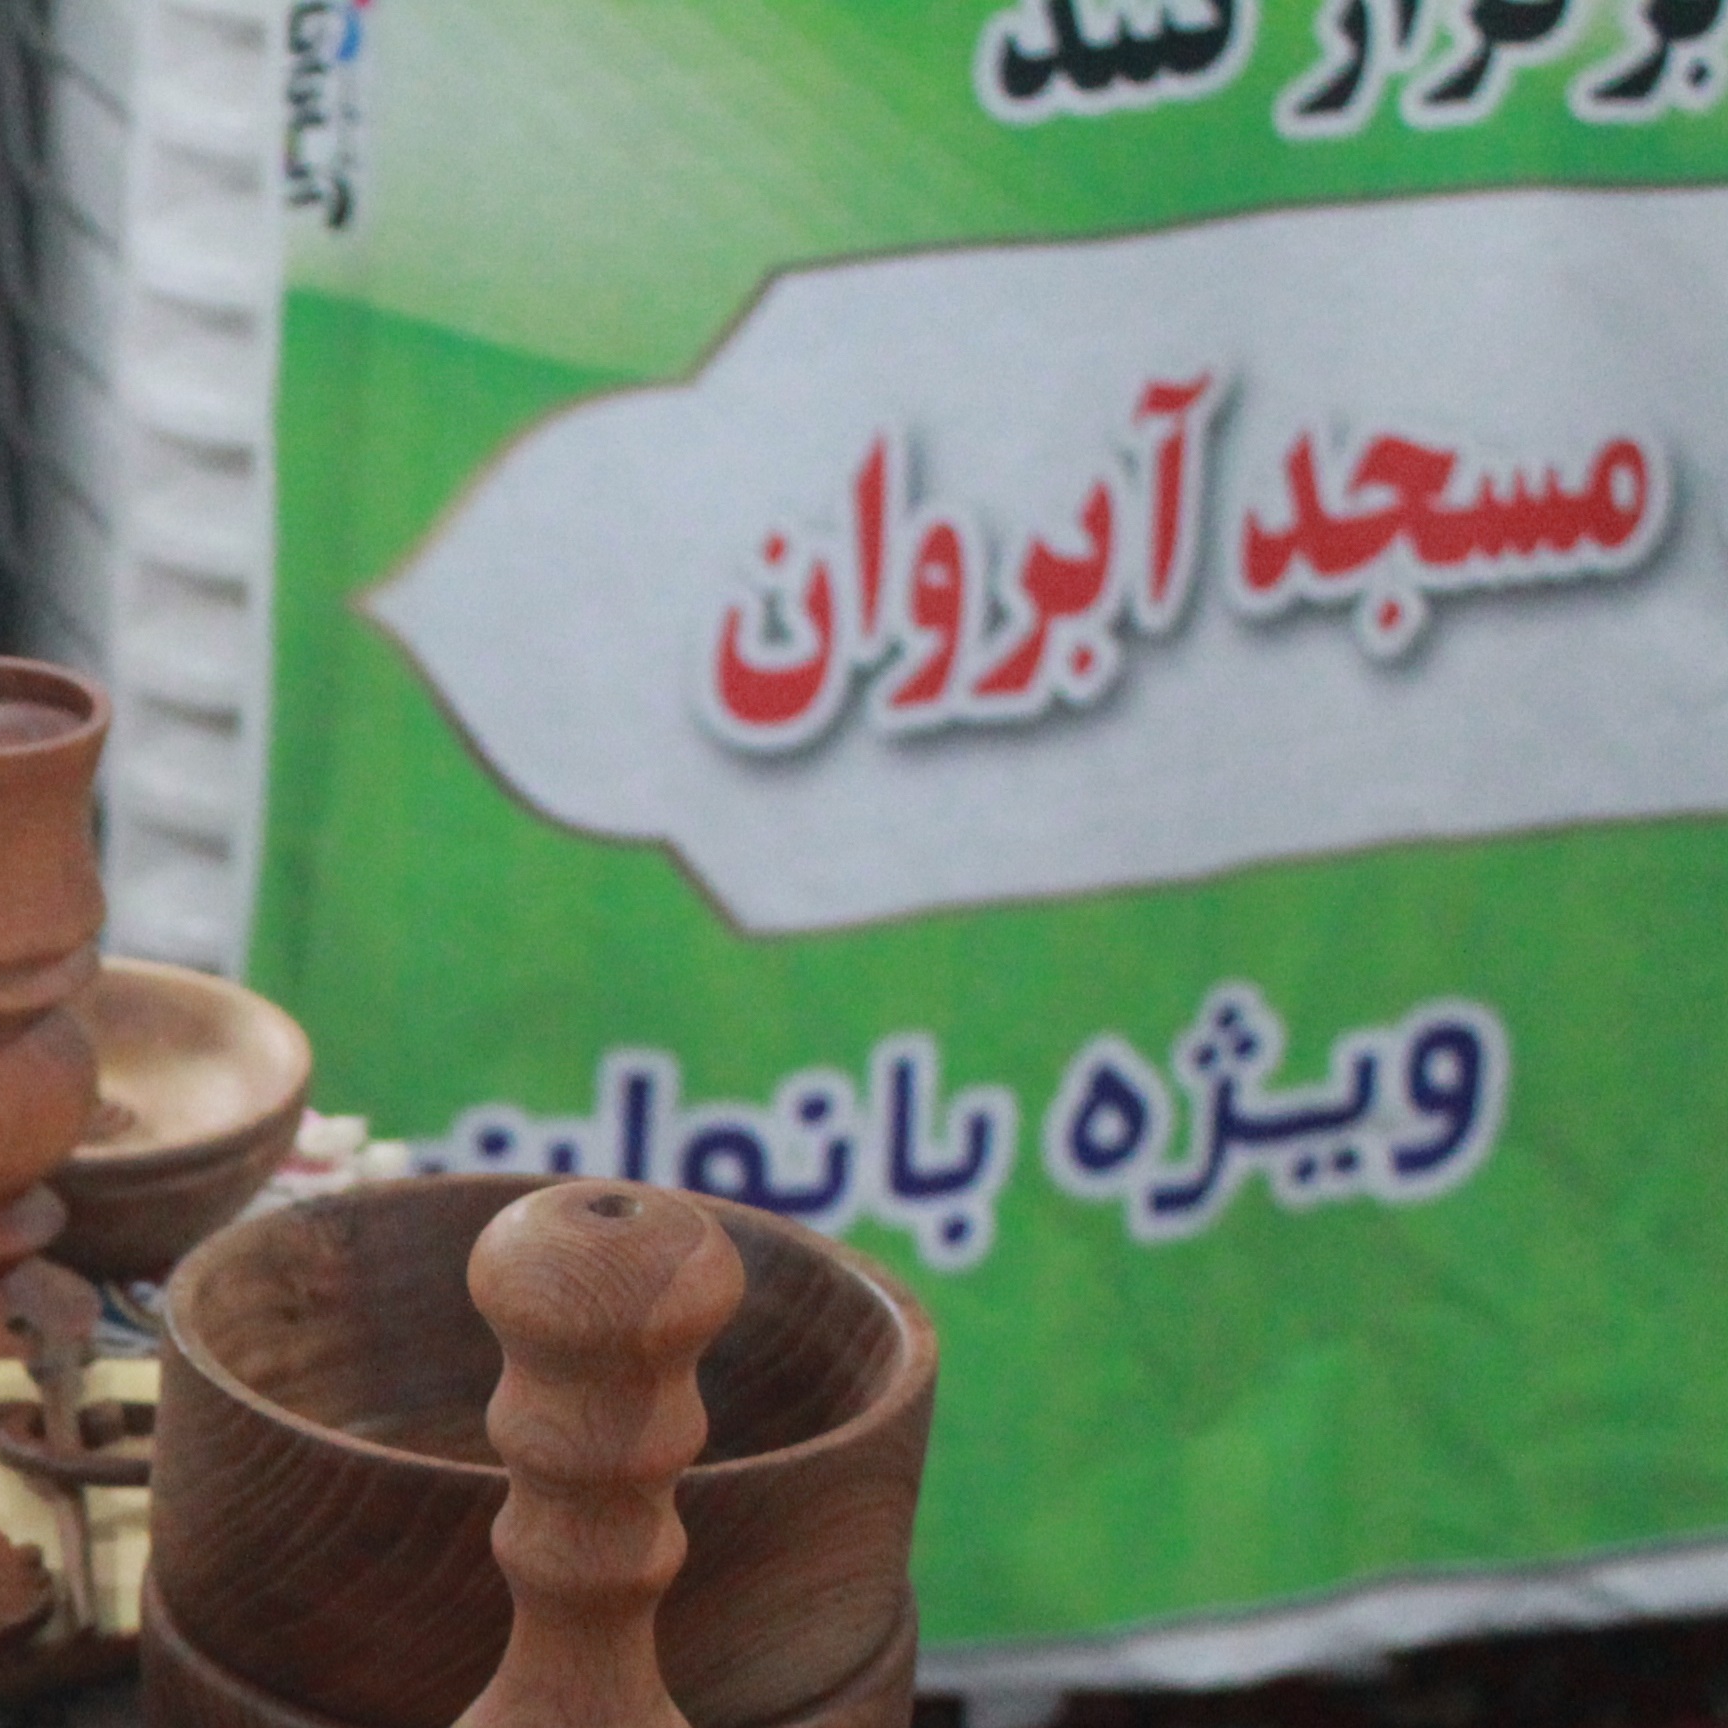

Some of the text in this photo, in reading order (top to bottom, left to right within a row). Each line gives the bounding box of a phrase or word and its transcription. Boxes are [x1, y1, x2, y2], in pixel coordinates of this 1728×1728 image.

[713, 375, 1651, 728] مسجد آبروان
[419, 1008, 1486, 1249] ویژه بانوا
